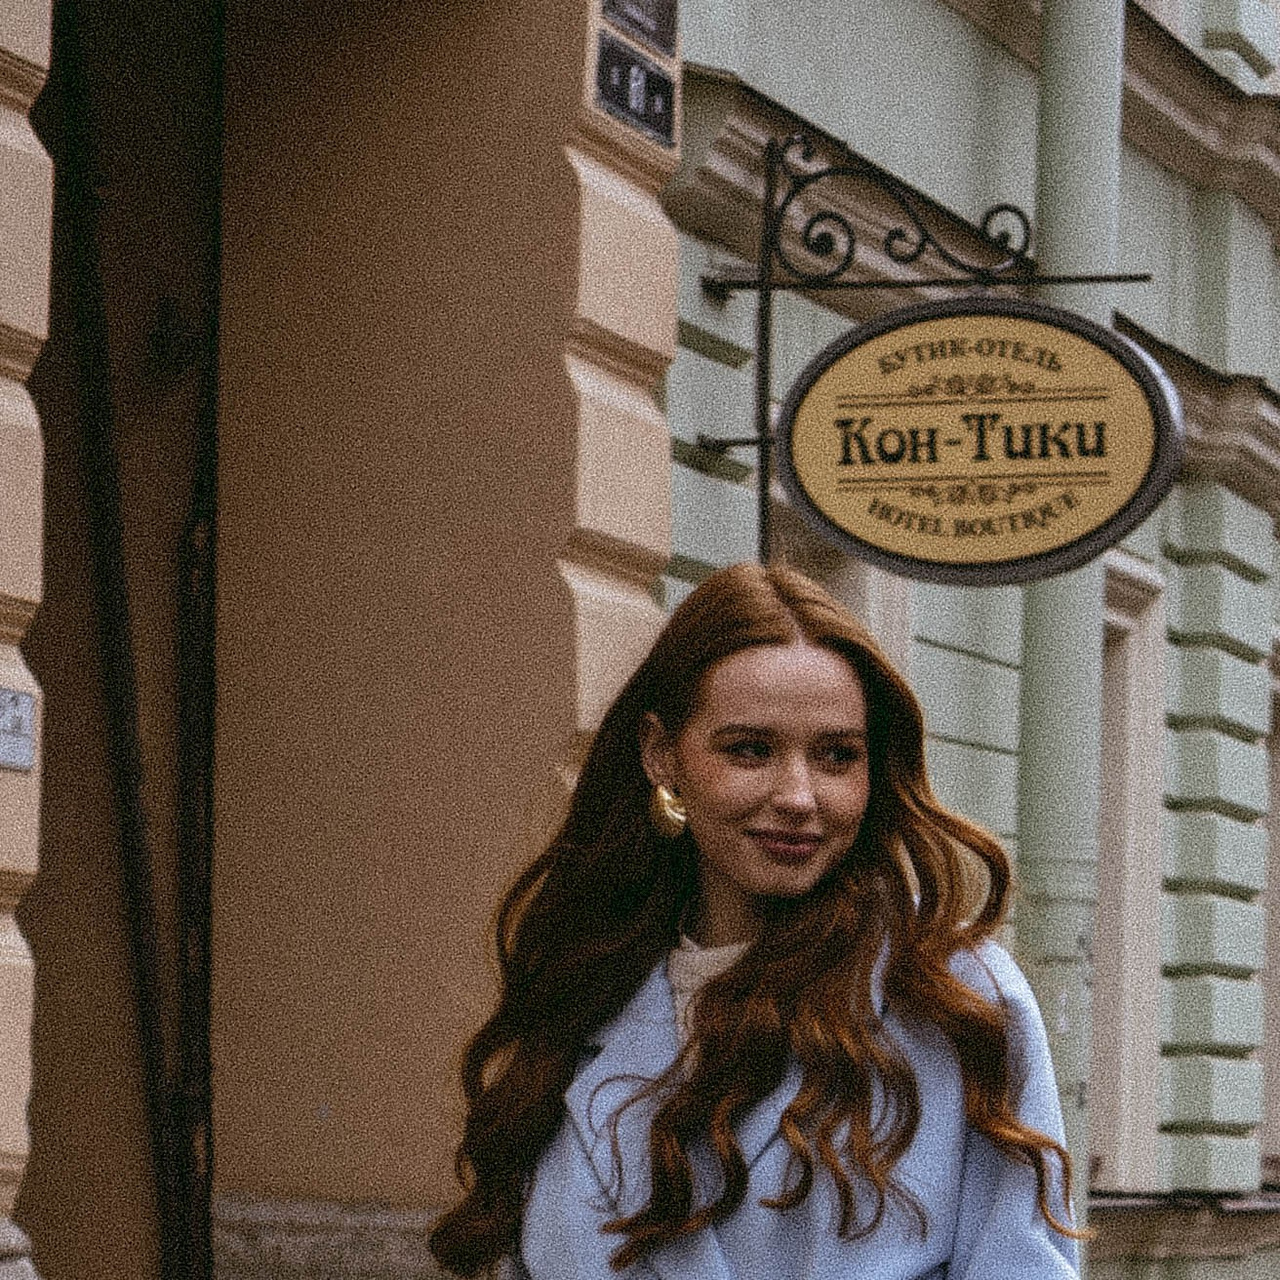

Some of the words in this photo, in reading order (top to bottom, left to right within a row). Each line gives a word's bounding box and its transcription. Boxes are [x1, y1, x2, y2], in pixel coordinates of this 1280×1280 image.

[878, 337, 1063, 375] БУТИК-ОТЕЛЬ
[834, 412, 1107, 466] Кон-Тики
[867, 497, 945, 536] HOTEL
